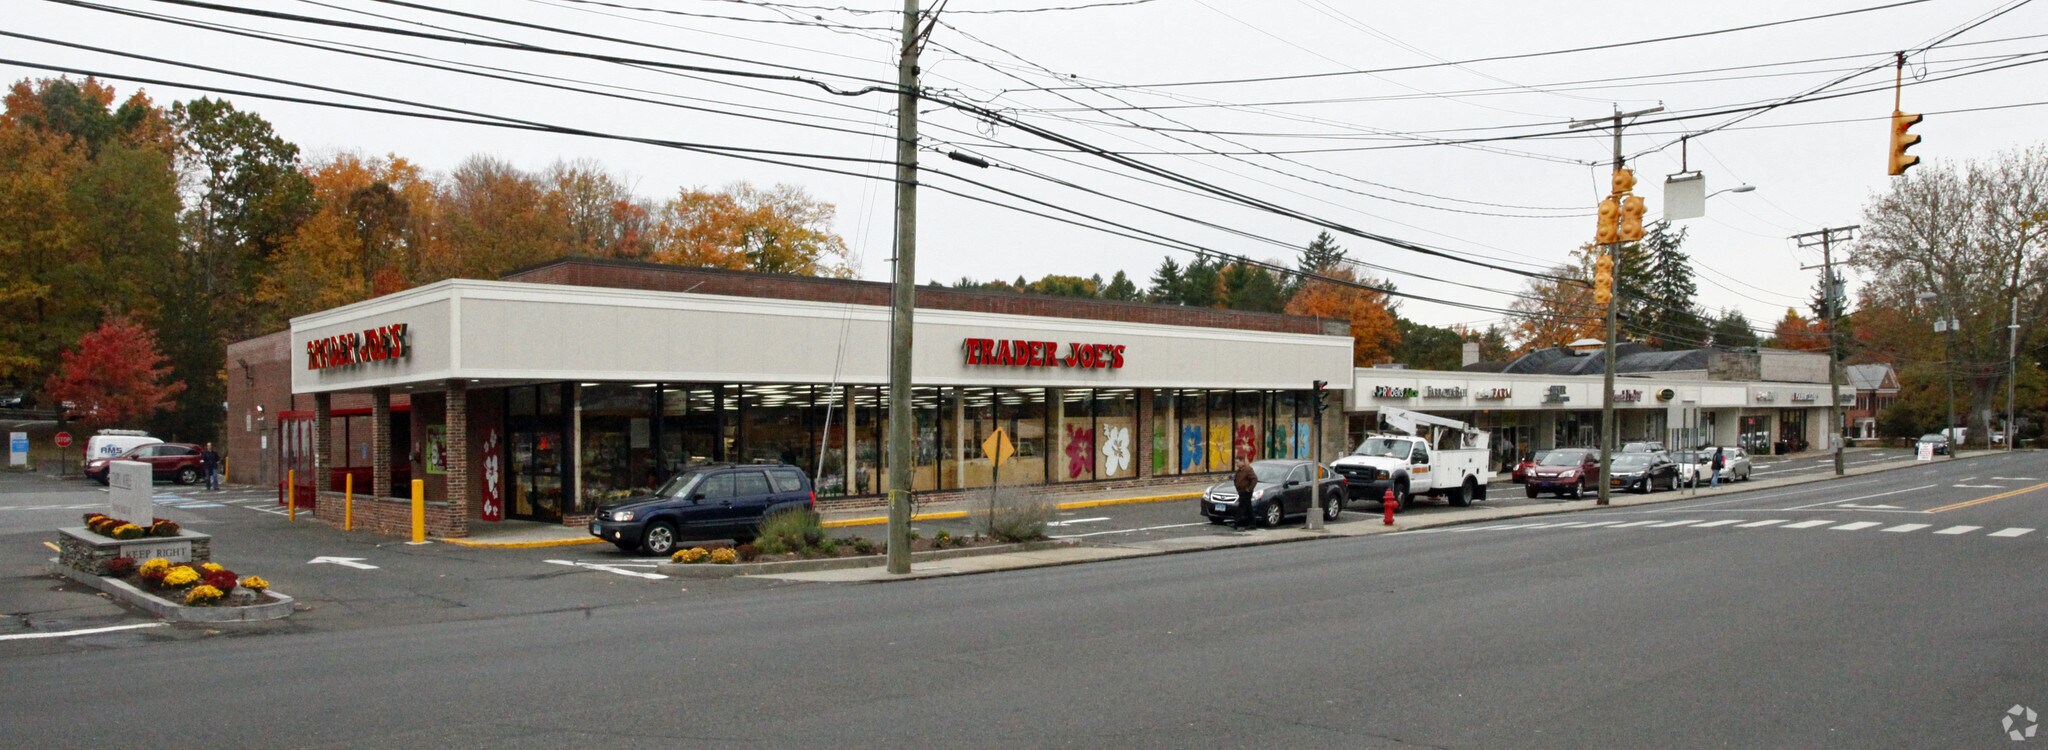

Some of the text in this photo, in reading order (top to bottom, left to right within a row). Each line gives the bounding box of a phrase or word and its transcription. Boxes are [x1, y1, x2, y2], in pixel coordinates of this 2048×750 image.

[962, 337, 1126, 368] TRADER JOE'S
[125, 547, 187, 559] KEEP RIGHT
